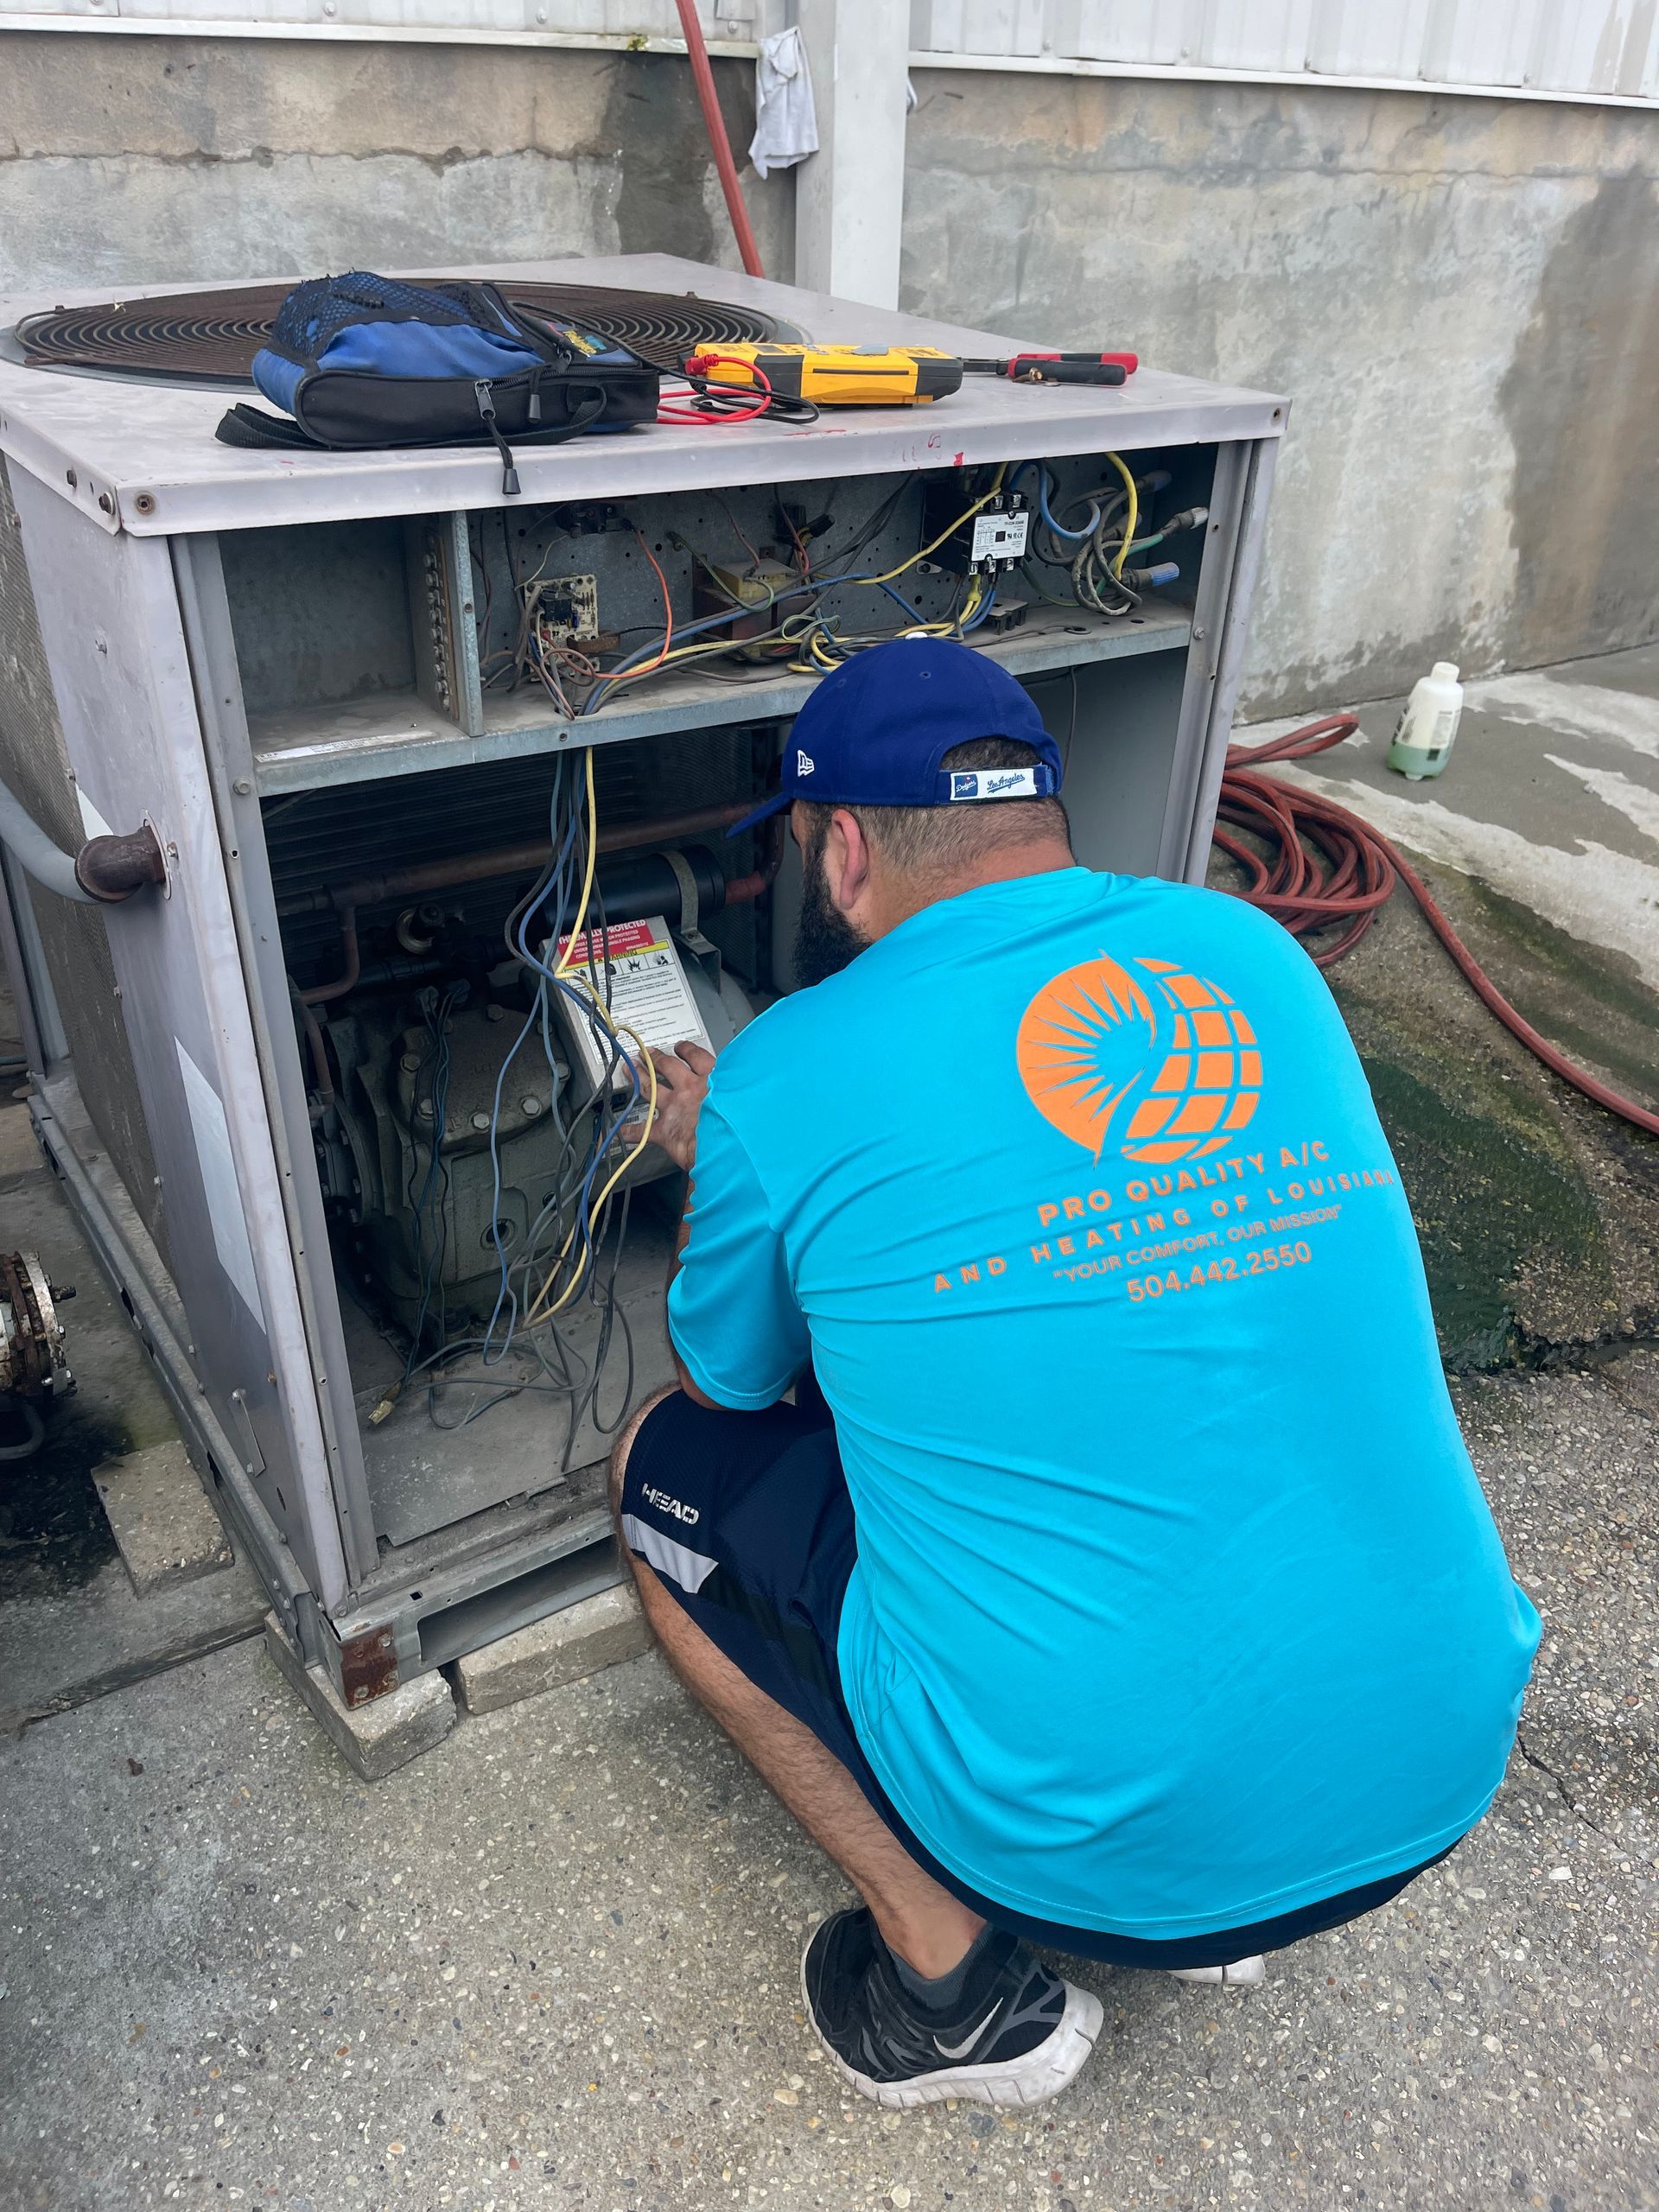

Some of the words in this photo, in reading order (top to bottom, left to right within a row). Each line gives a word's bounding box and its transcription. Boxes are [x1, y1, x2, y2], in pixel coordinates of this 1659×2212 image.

[956, 780, 976, 792] Dodgers
[998, 773, 1026, 789] Angeles
[1038, 1189, 1111, 1227] PRO
[1126, 1153, 1265, 1202] QUALITY
[1281, 1141, 1330, 1167] A/C
[934, 1257, 1007, 1293] AND
[1031, 1209, 1190, 1264] HEATING
[1211, 1195, 1249, 1217] OF
[1268, 1171, 1394, 1205] LOUISIANA
[1053, 1255, 1122, 1283] "YOUR
[1126, 1232, 1224, 1266] COMFORT,
[1227, 1222, 1267, 1242] OUR
[1269, 1205, 1342, 1231] MISSION"
[1127, 1242, 1312, 1302] 504.442.2550
[642, 1483, 700, 1525] HEAD
